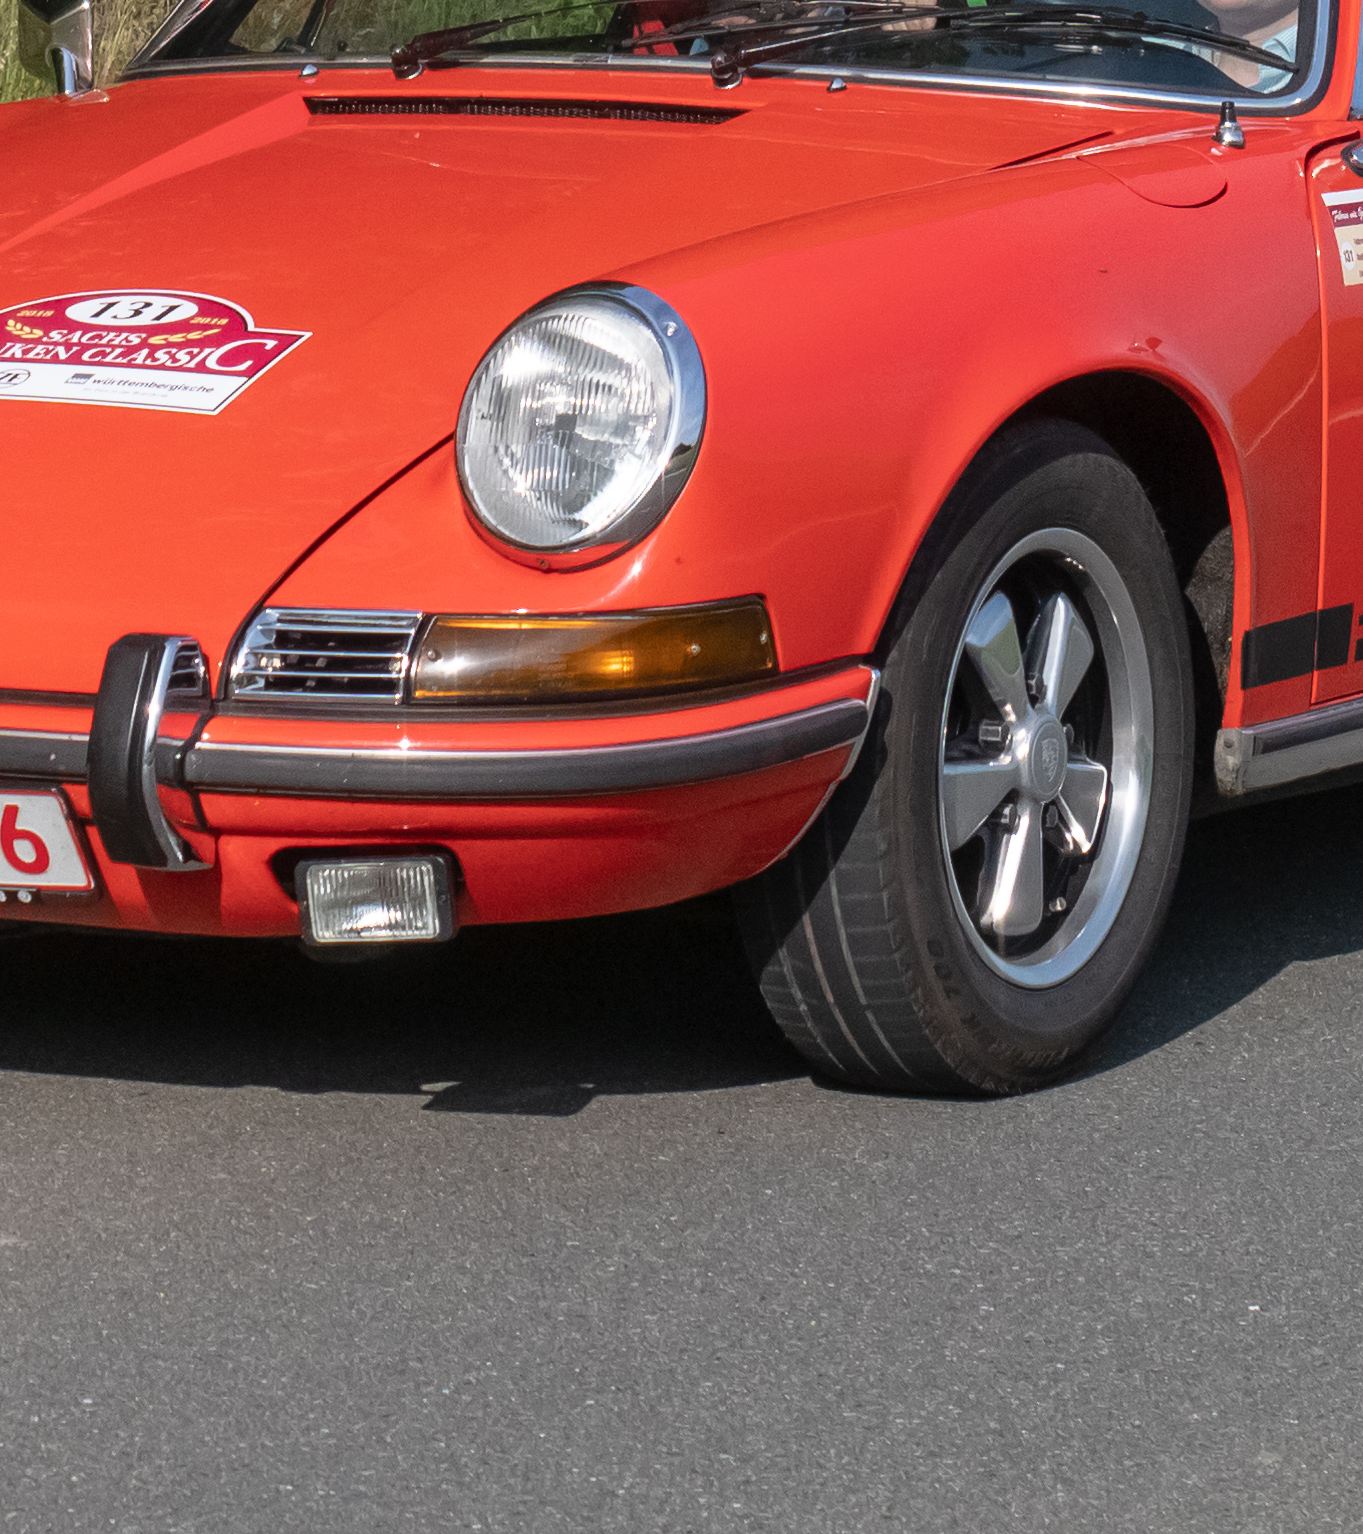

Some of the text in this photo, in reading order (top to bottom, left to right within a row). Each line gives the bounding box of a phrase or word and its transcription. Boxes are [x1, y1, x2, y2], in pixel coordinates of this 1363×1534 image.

[89, 300, 184, 323] 131
[189, 316, 229, 326] 2018
[42, 329, 146, 346] SACHS
[81, 338, 279, 372] CLASSIC
[92, 377, 215, 394] württembergische
